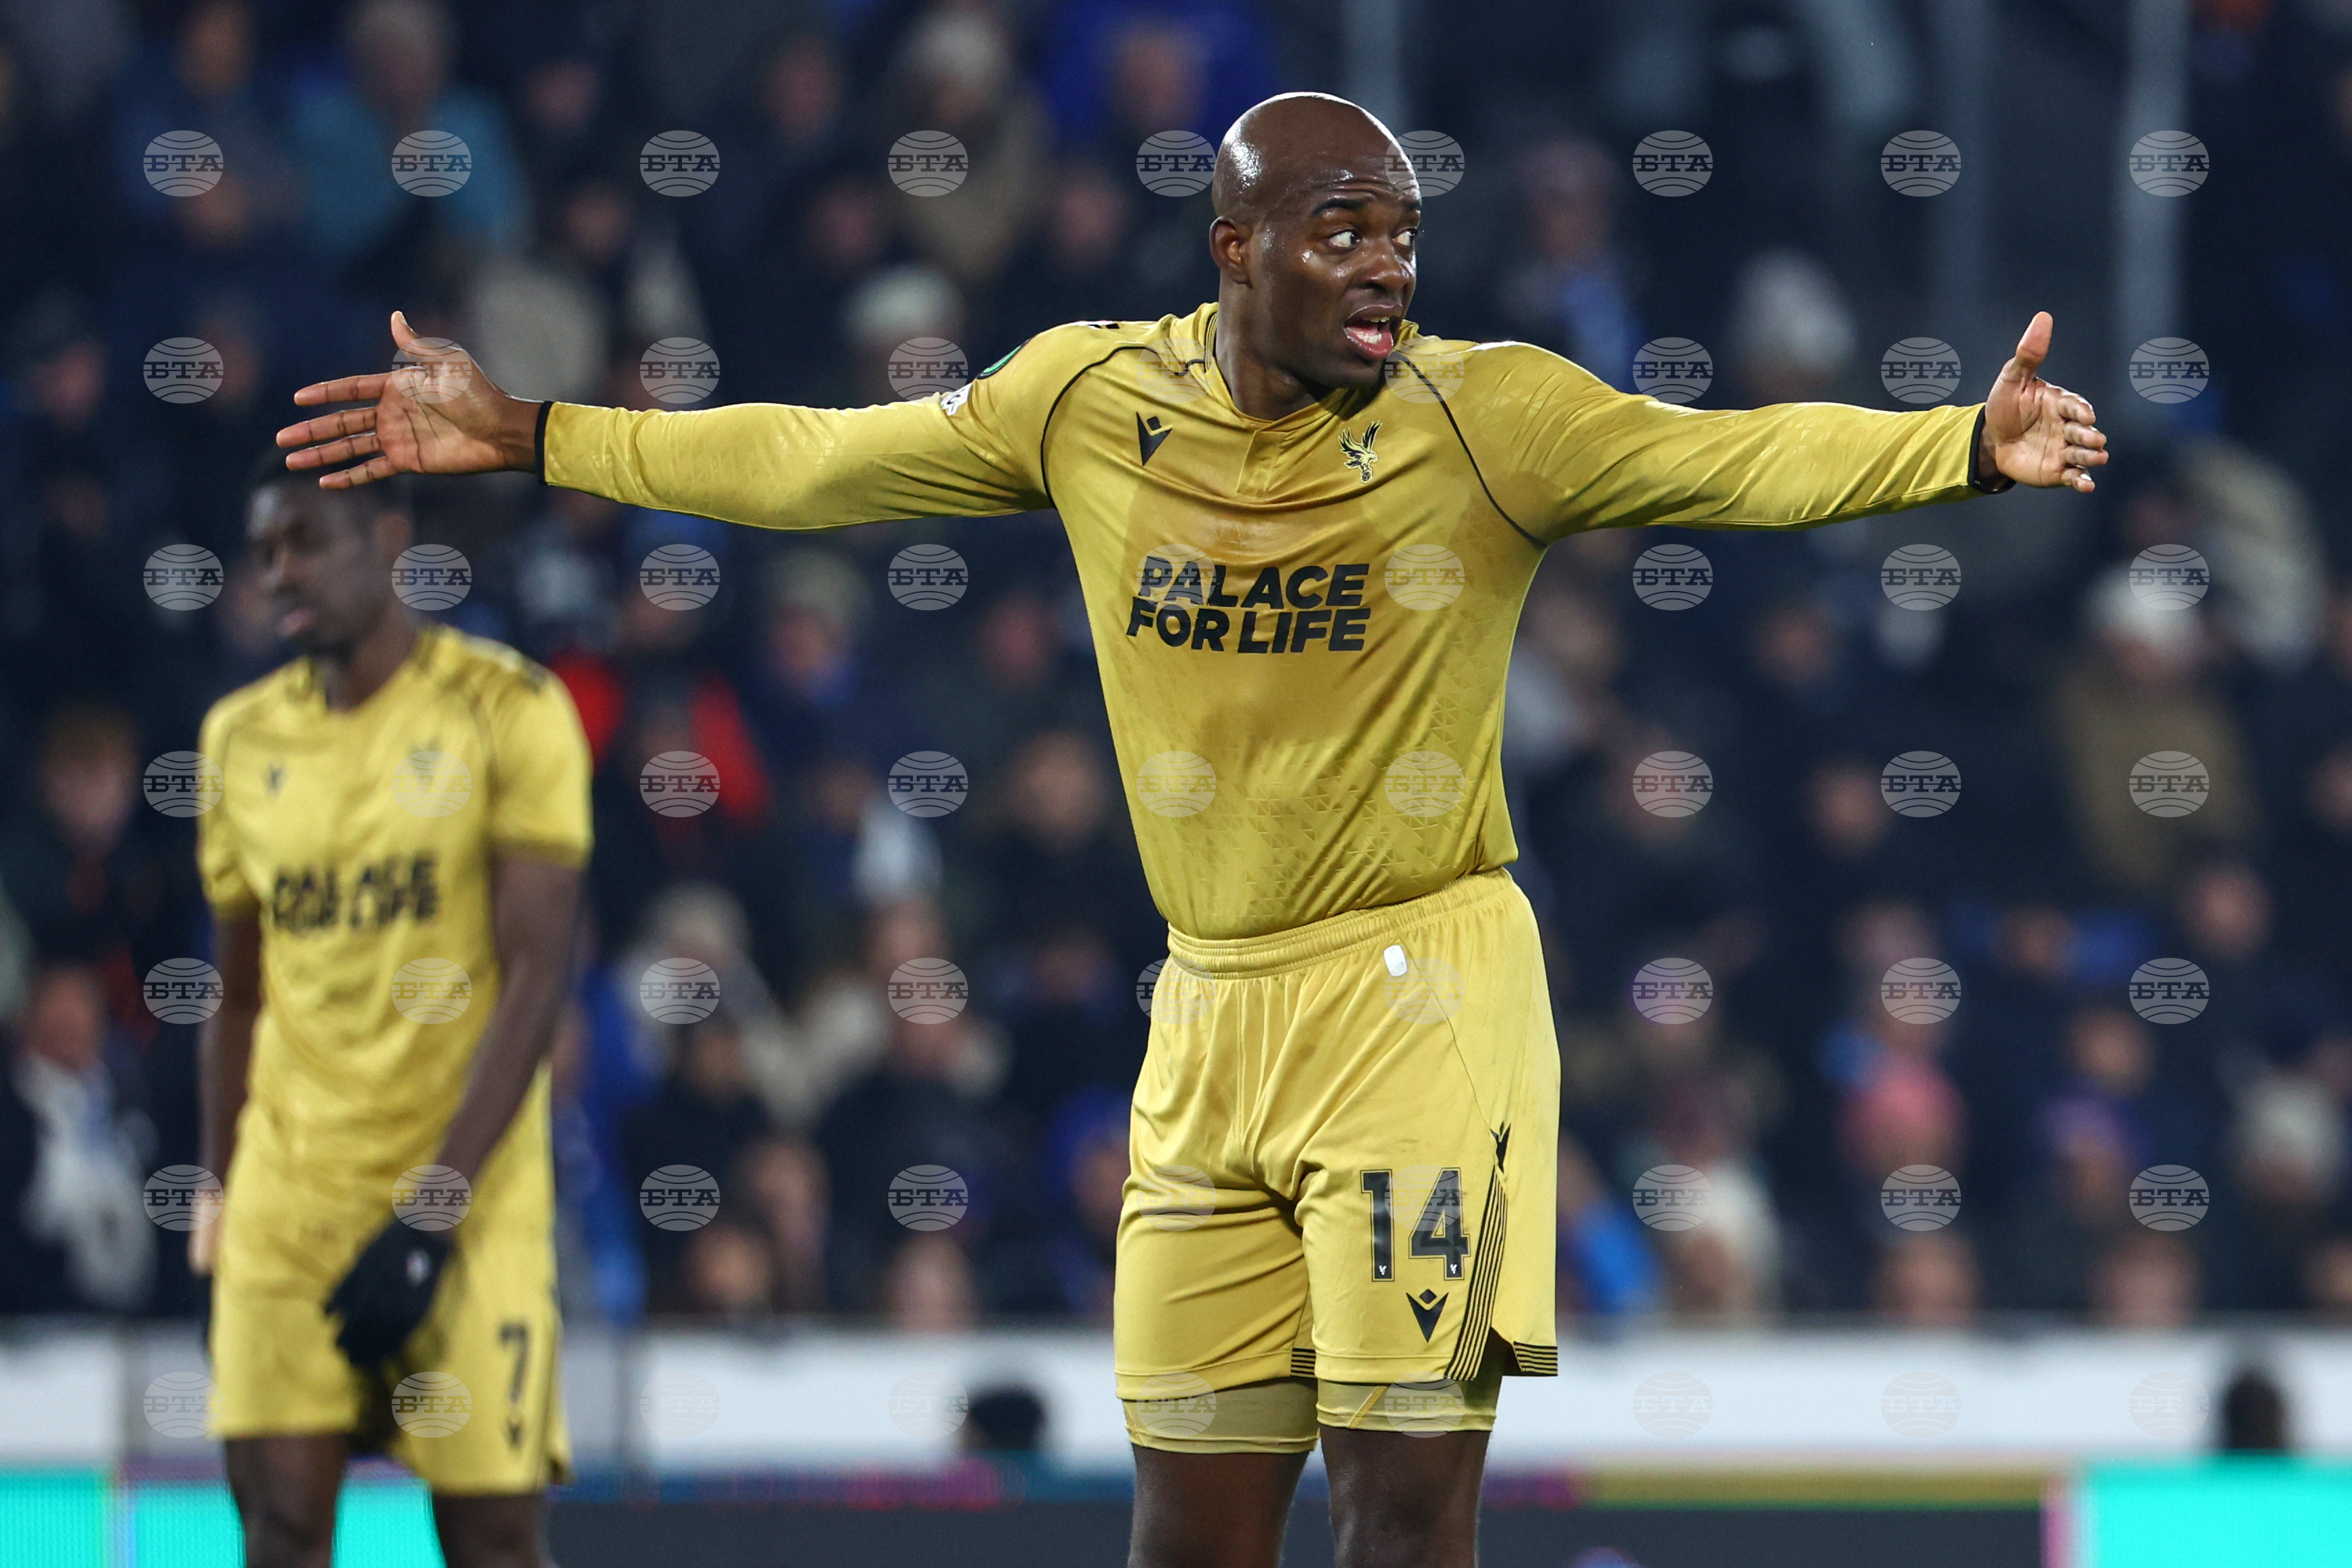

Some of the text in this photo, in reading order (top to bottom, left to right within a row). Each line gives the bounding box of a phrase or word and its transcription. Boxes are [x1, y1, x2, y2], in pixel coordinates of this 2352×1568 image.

[1138, 556, 1370, 610] PALACE
[1126, 596, 1371, 654] FOR LIFE
[1360, 1167, 1471, 1282] 14
[499, 1318, 530, 1403] 7
